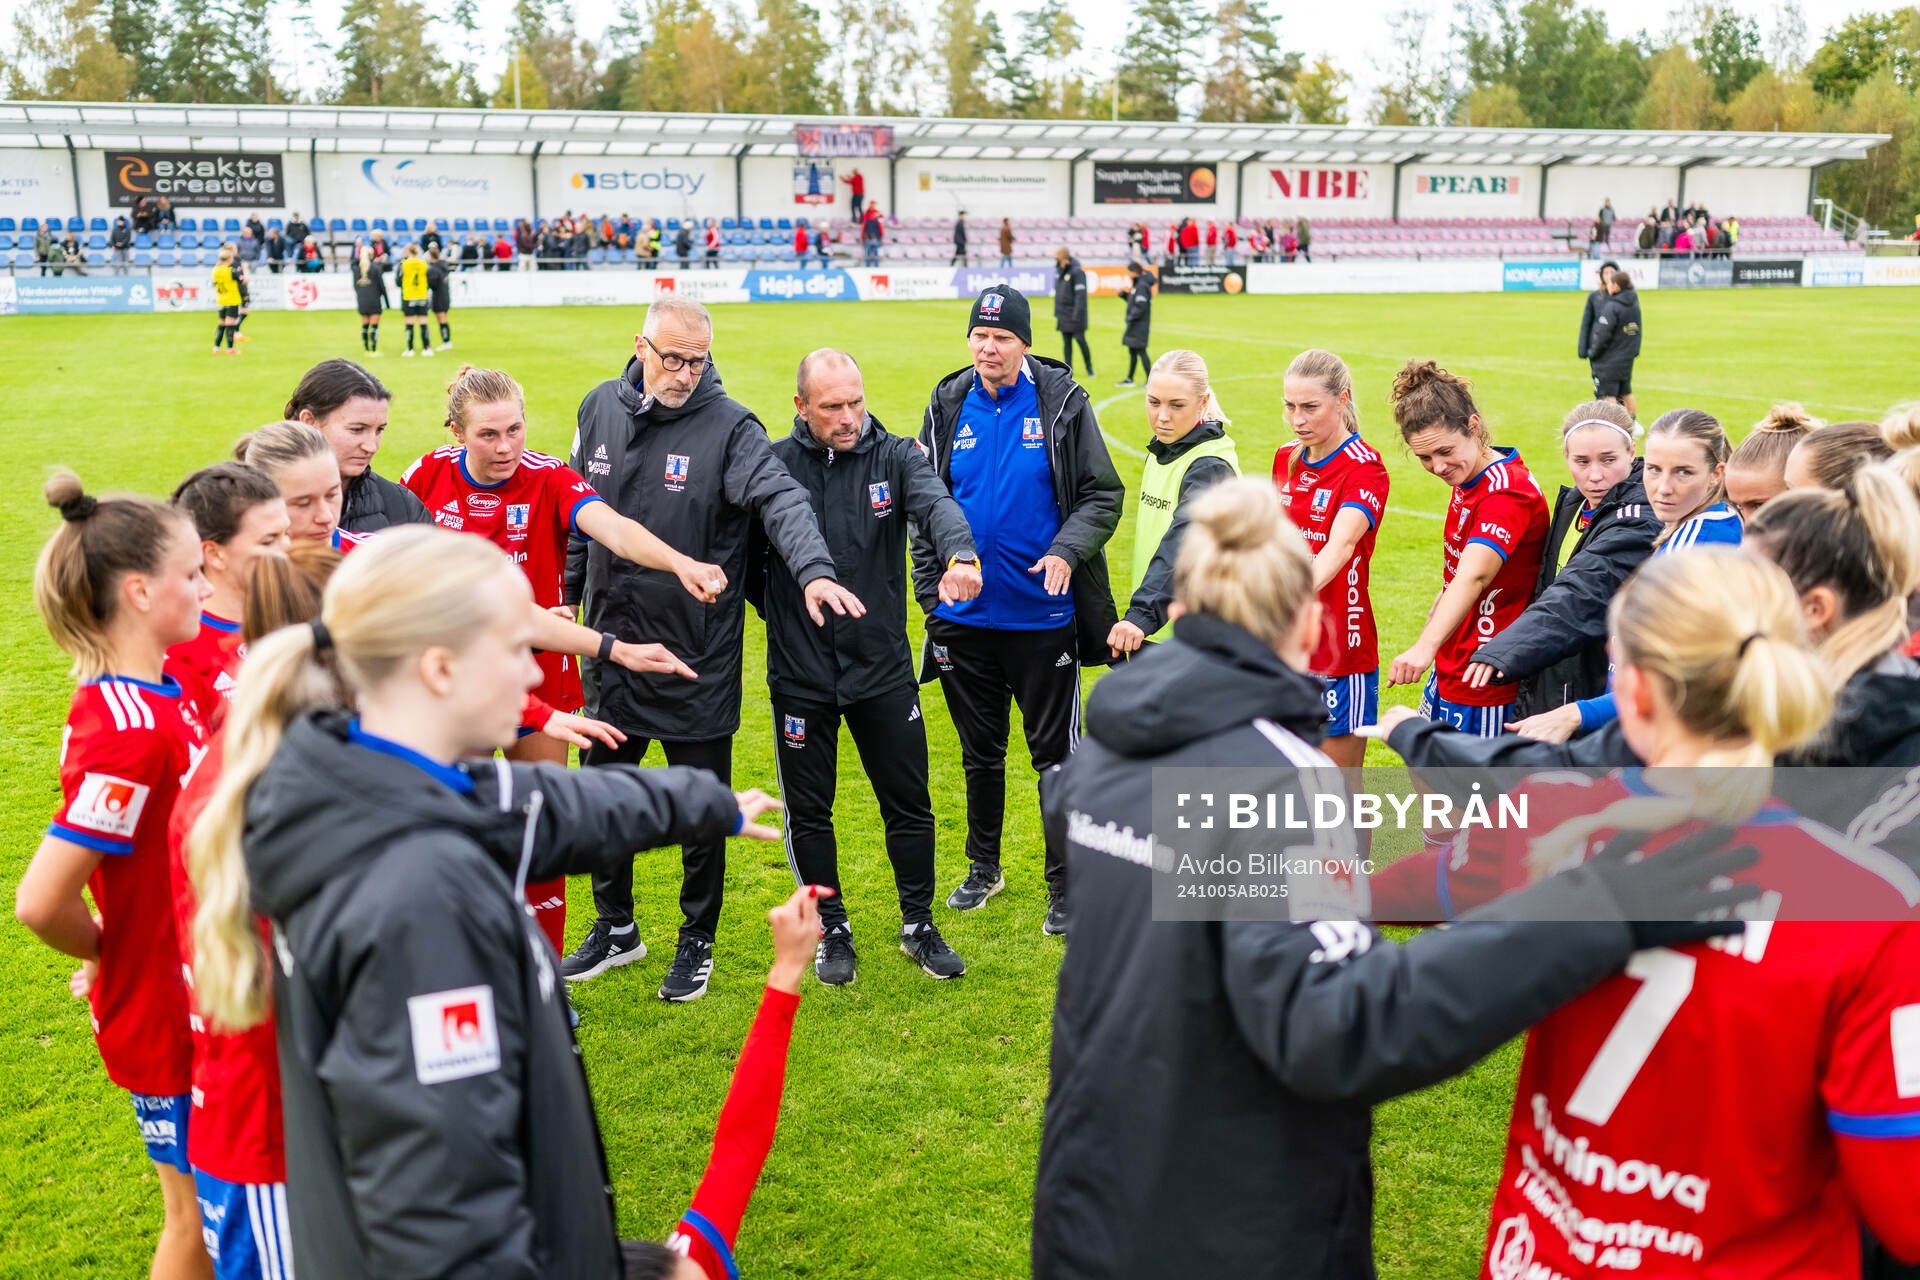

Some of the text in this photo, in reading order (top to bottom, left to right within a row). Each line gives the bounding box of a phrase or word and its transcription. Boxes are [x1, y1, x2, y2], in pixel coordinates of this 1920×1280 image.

[154, 156, 275, 178] exakta
[155, 178, 275, 194] creative
[599, 167, 704, 195] stoby
[1268, 169, 1368, 200] NIBE
[1428, 175, 1507, 194] PEAB
[759, 274, 804, 298] Heja
[593, 467, 610, 476] SPORT
[594, 462, 611, 470] INTER
[442, 519, 463, 531] SPORT
[445, 513, 464, 525] INTER
[1347, 555, 1364, 648] eolus
[1477, 588, 1503, 652] eol
